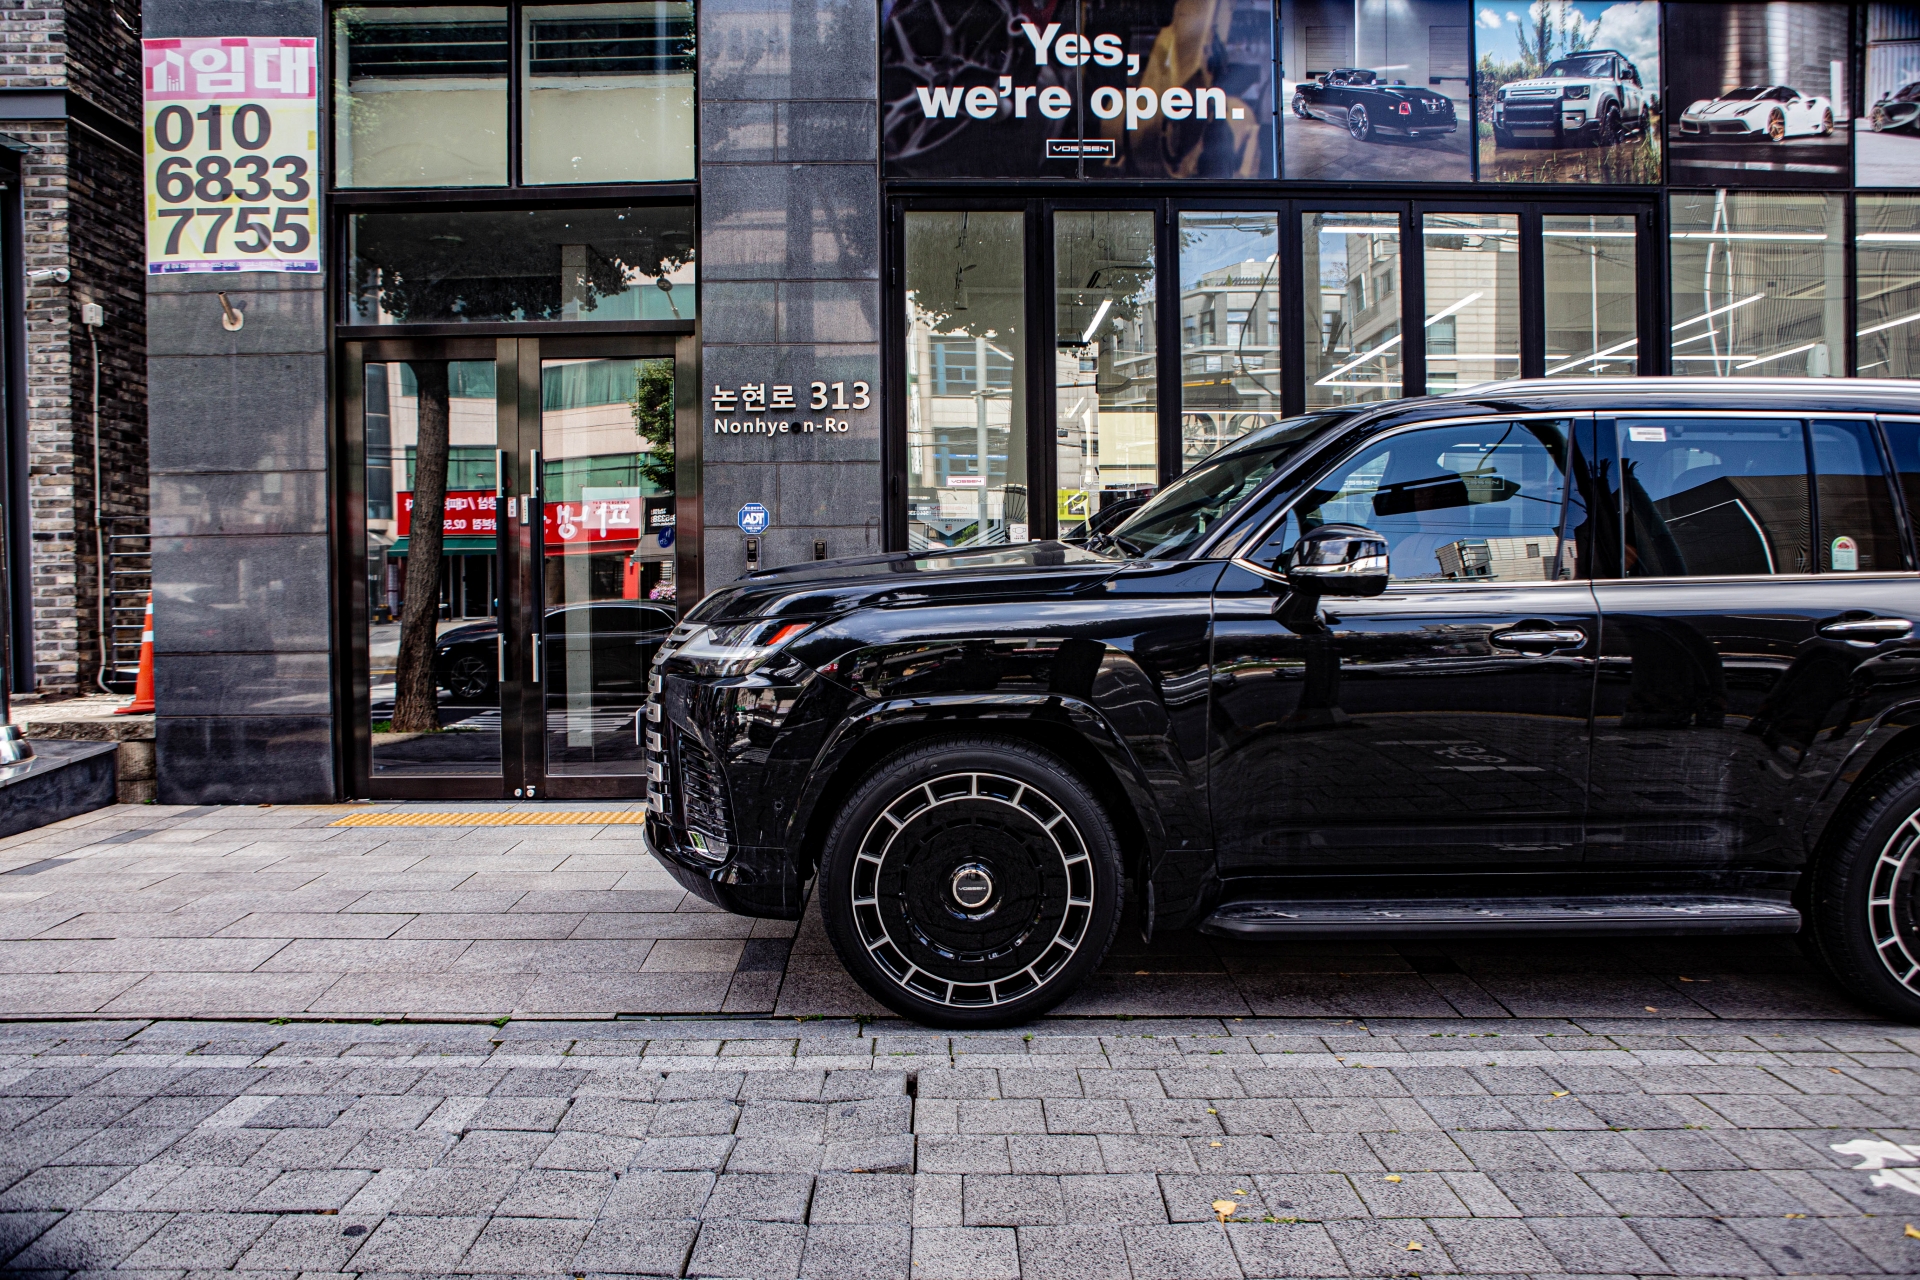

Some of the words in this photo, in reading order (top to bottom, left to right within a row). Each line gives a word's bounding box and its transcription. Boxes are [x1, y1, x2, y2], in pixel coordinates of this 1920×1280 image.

[189, 46, 310, 94] 임대
[1021, 22, 1140, 76] Yes,
[916, 75, 1072, 120] we're
[1090, 86, 1245, 130] open.
[154, 103, 272, 152] 010
[156, 155, 311, 204] 6833
[158, 206, 311, 255] 7755
[711, 382, 797, 412] 논현로
[810, 381, 871, 410] 313
[714, 417, 849, 437] Nonhyen-Ro
[742, 512, 765, 525] ADT
